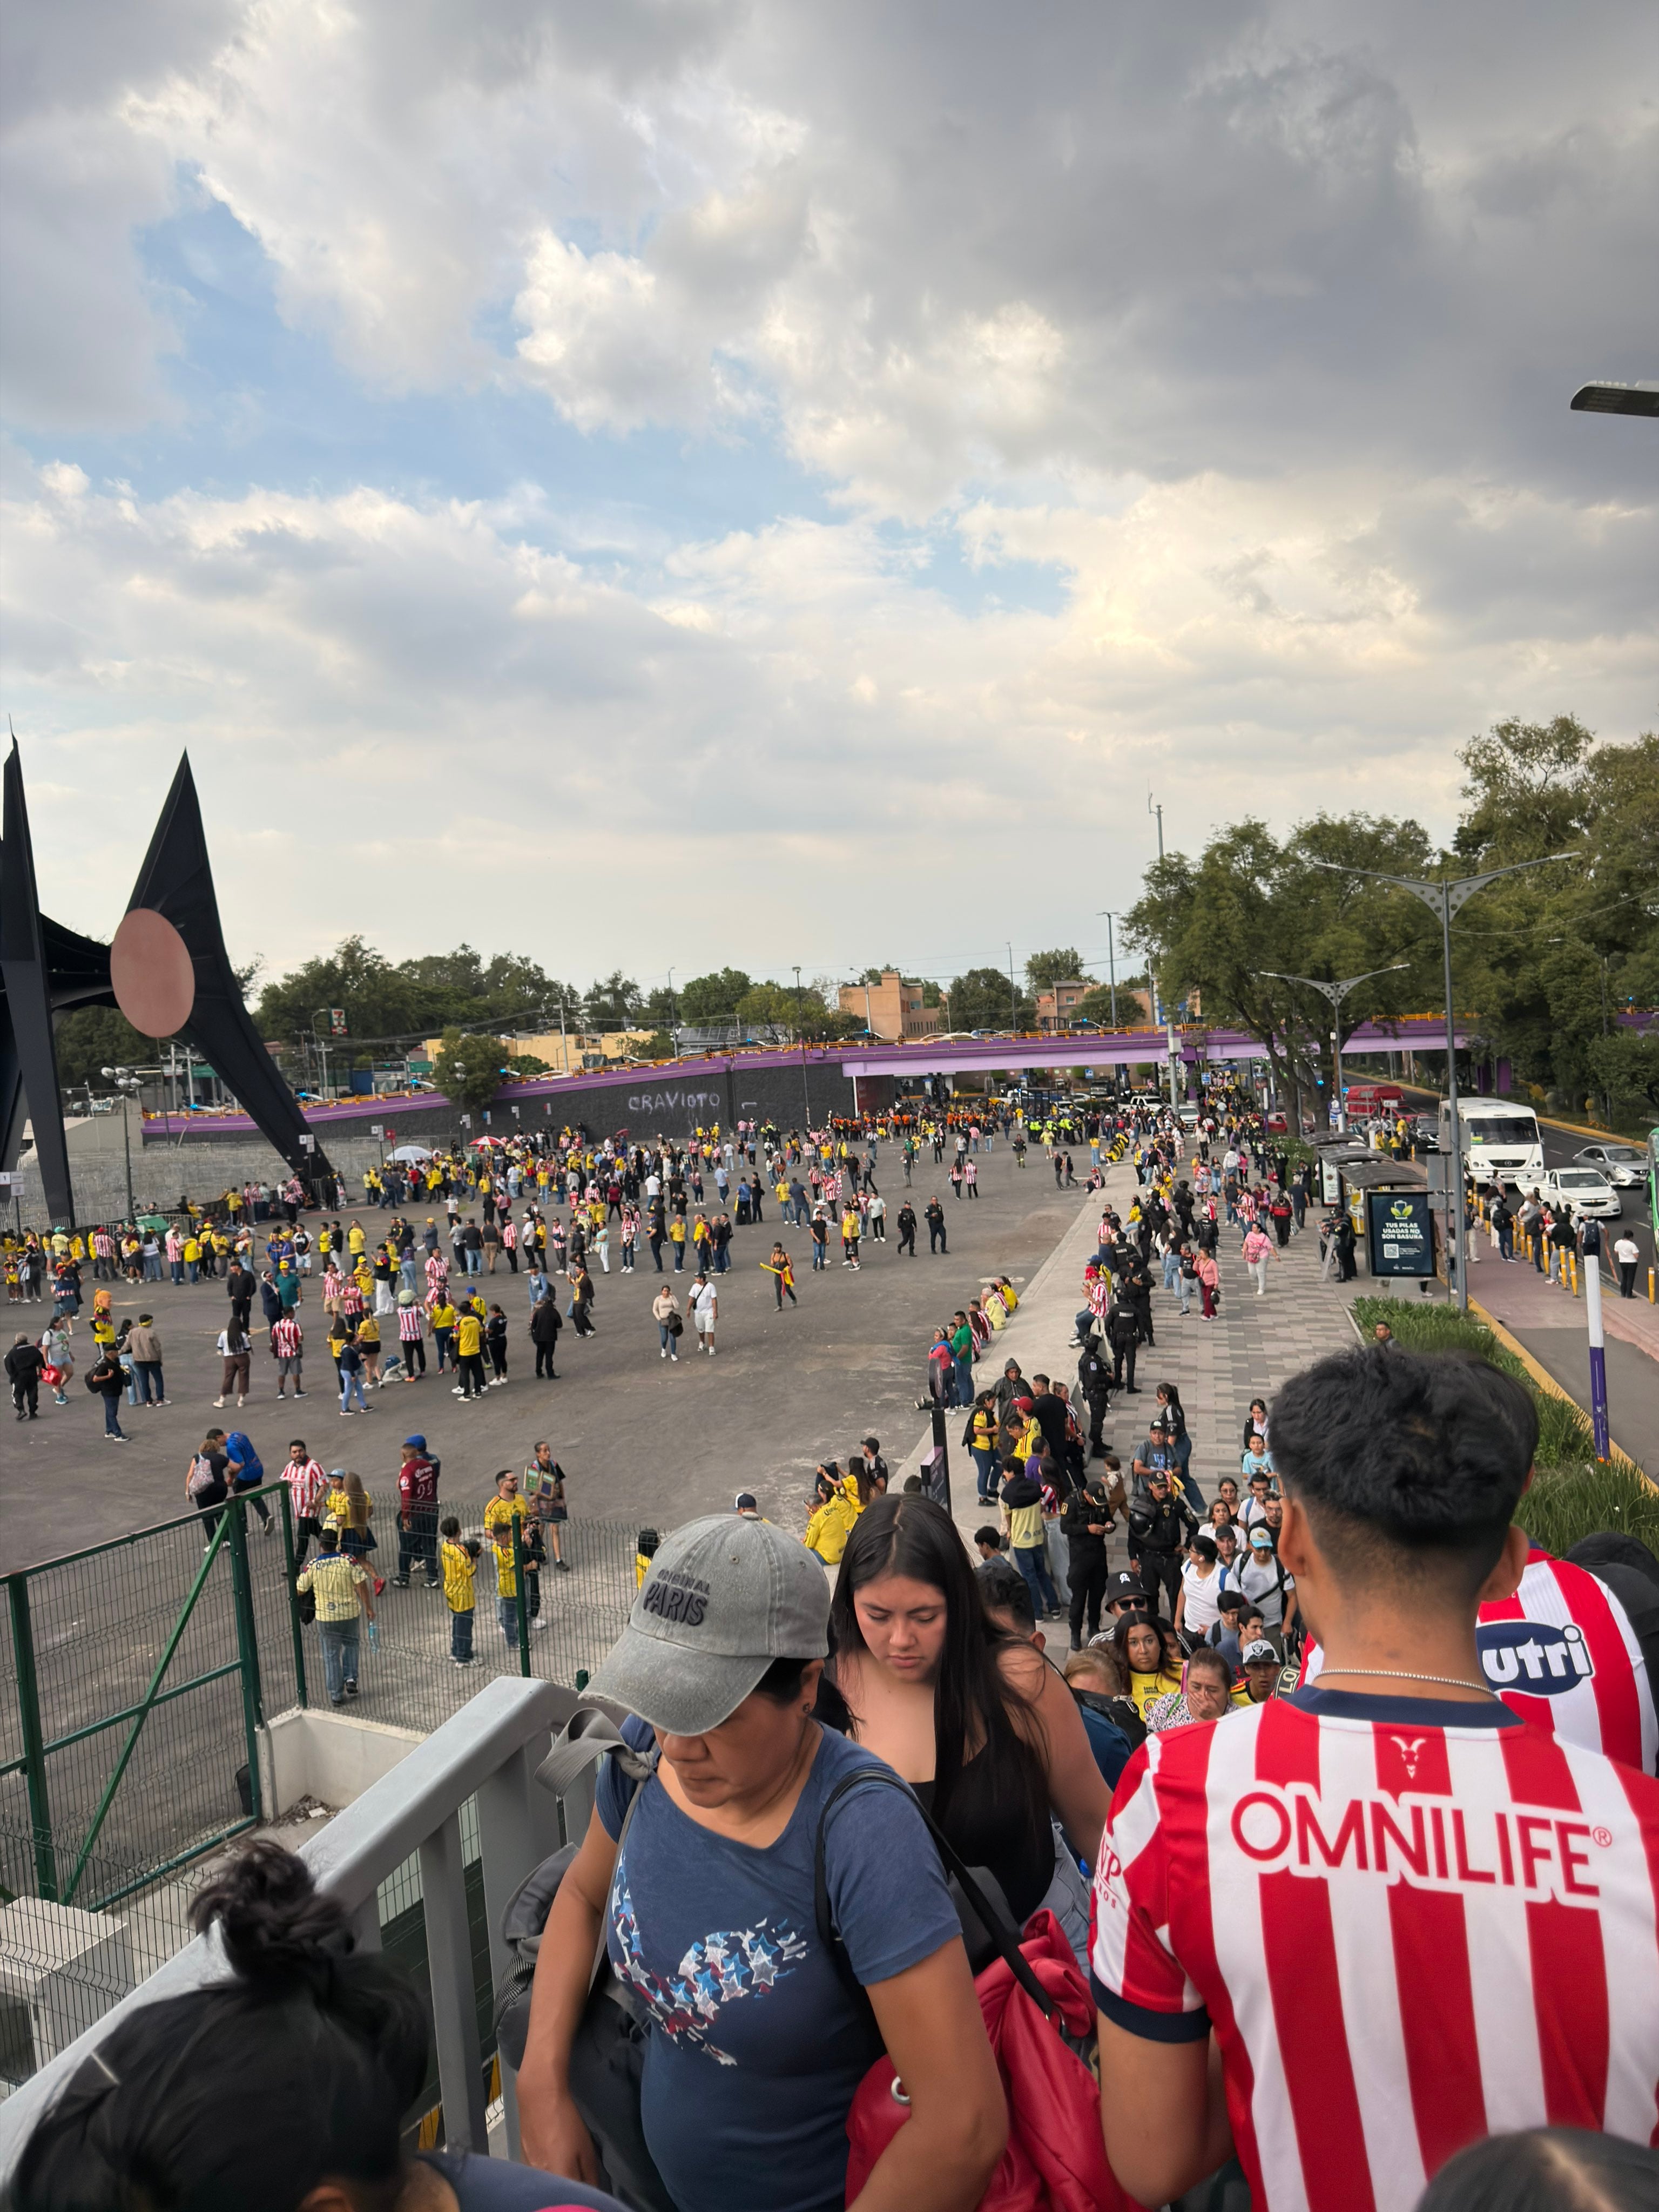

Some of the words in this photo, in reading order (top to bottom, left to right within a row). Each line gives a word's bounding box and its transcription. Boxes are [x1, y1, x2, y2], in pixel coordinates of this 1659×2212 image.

[643, 1581, 707, 1626] PARIS
[657, 1569, 710, 1595] ORIGINAL
[1482, 1626, 1591, 1682] utri
